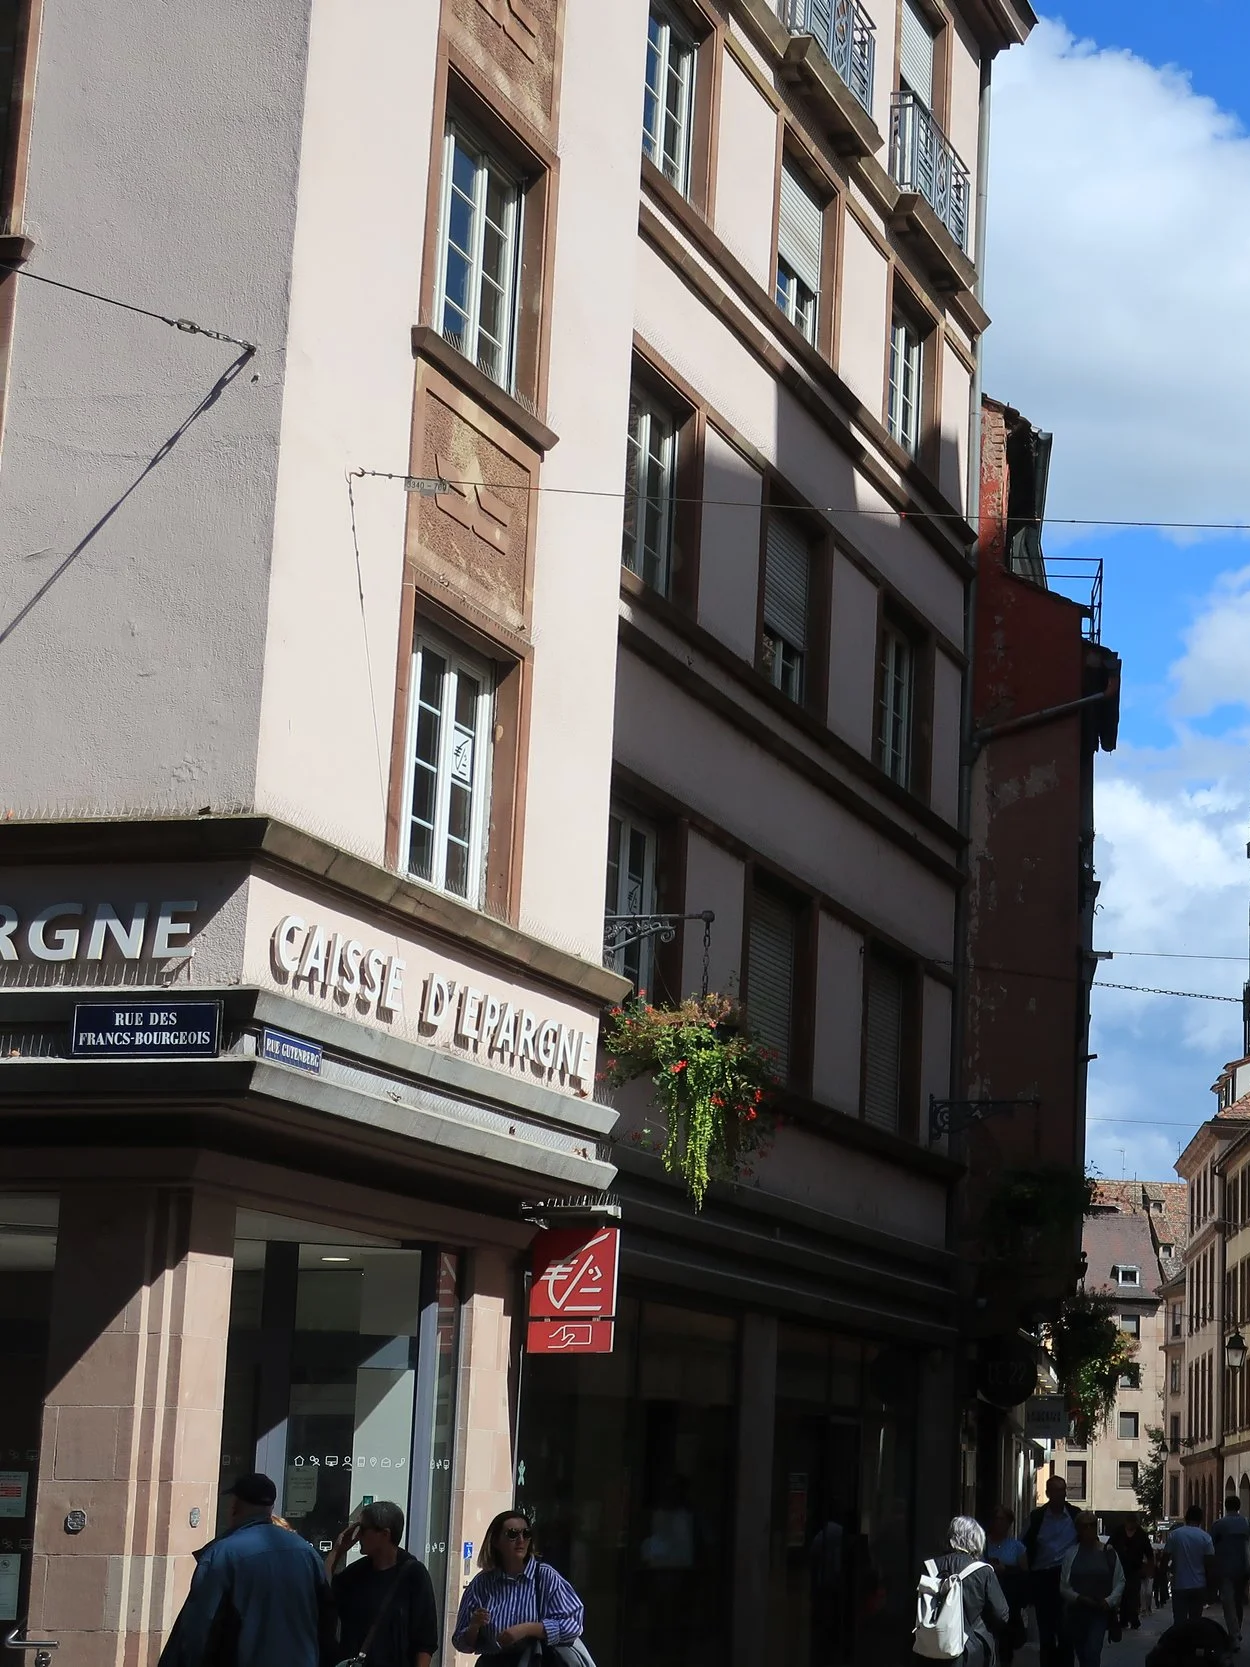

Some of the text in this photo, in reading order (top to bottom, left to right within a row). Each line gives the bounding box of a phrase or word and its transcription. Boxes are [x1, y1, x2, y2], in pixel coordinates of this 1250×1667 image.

[275, 915, 594, 1081] CAISSE D'EPARGNE
[115, 1012, 177, 1026] RUE DES
[79, 1031, 211, 1046] FRANCS-BOURGEOIS
[266, 1037, 320, 1068] RUE GUTENBERG
